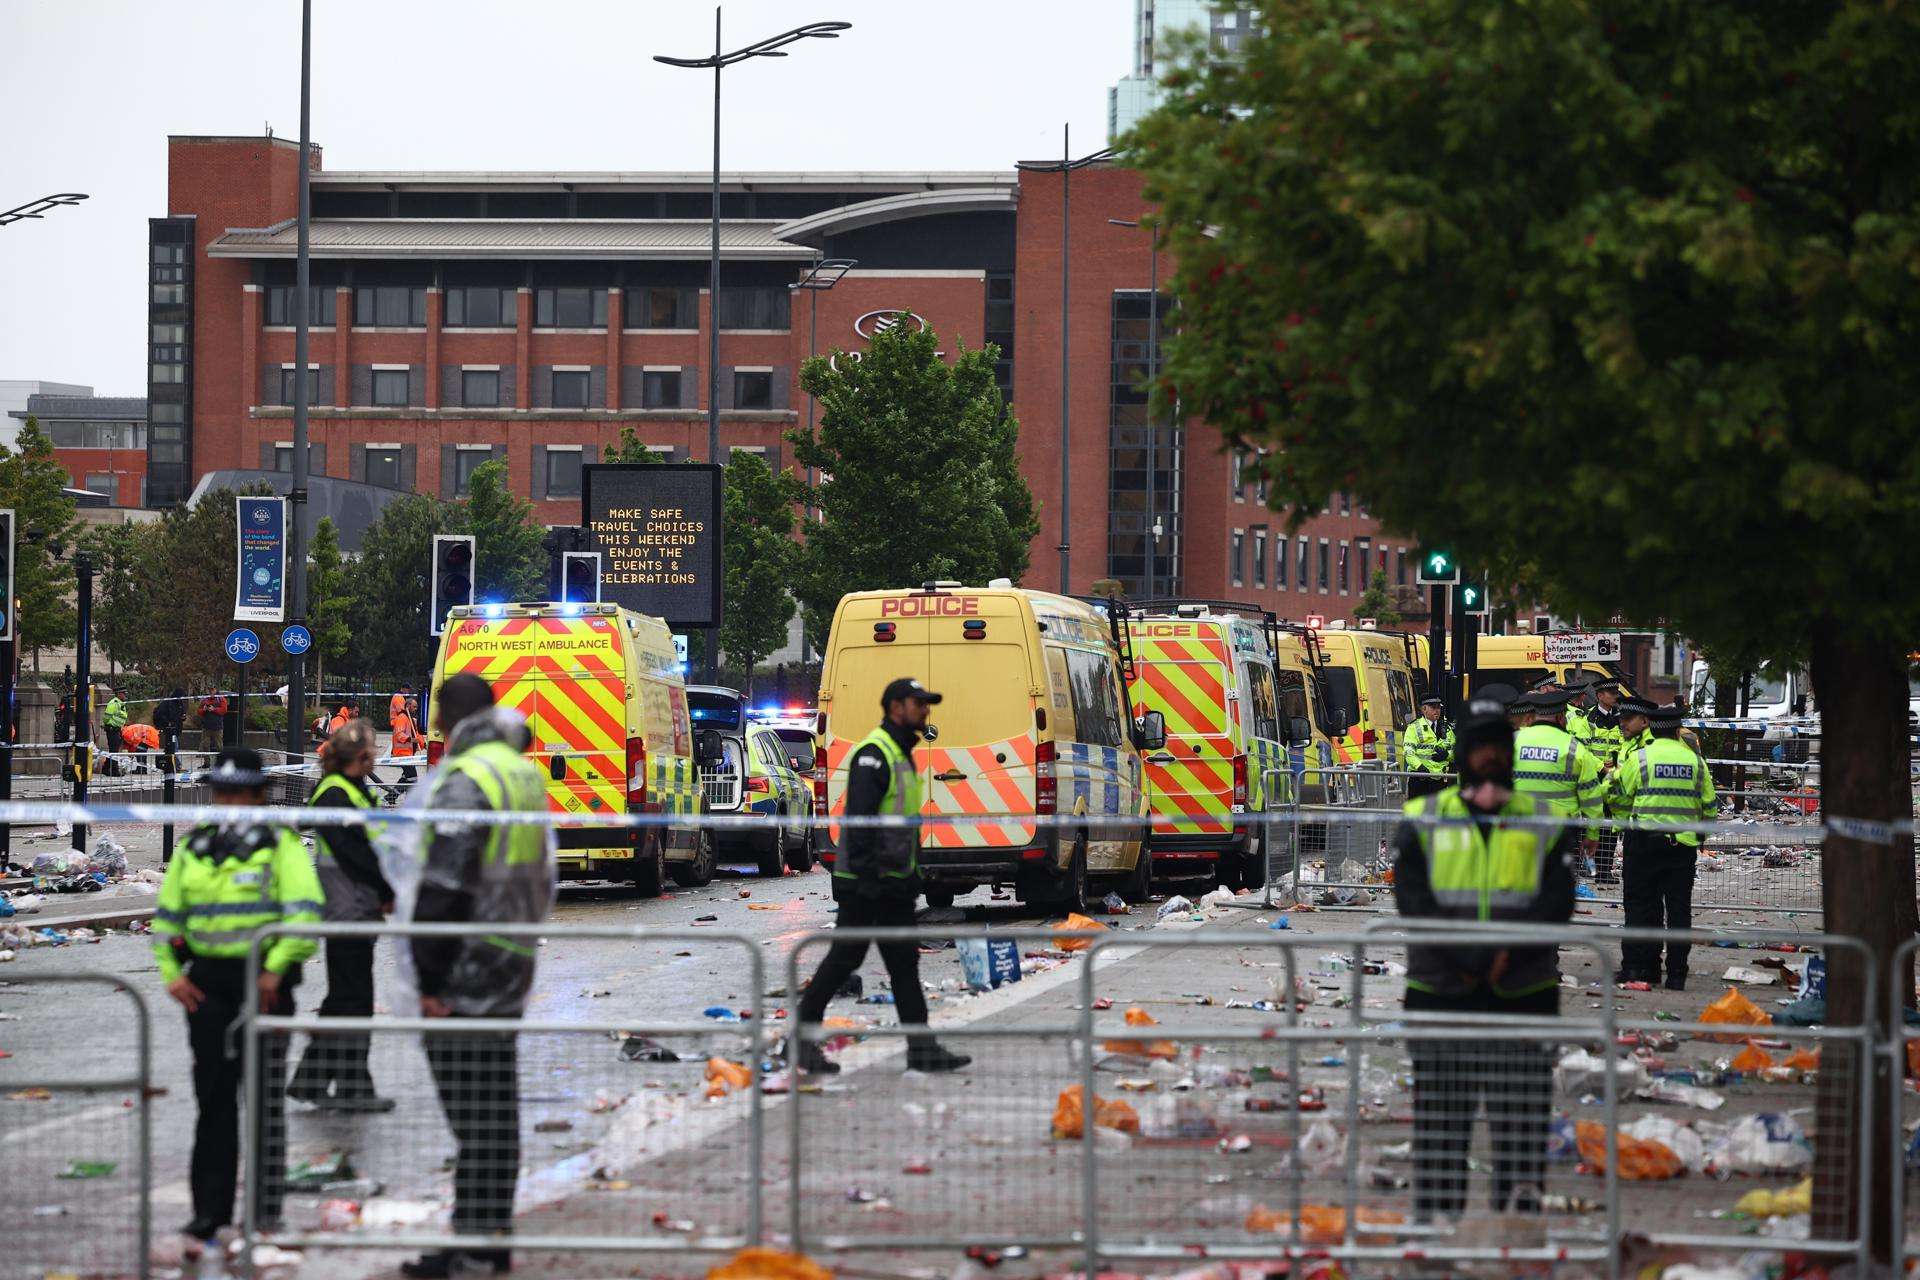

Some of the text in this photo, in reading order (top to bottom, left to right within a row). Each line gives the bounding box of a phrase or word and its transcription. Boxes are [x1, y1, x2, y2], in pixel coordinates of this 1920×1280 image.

[609, 508, 683, 519] MAKE SAFE
[590, 521, 704, 532] TRAVEL CHOICES
[598, 534, 696, 545] THIS WEEKEND
[609, 547, 683, 558] ENJOY THE
[614, 560, 679, 571] EVENTS &
[600, 573, 696, 584] CELEBRATIONS
[881, 596, 979, 618] POLICE
[459, 624, 490, 634] A670
[592, 620, 608, 628] NHS
[458, 639, 609, 651] NORTH WEST AMBULANCE
[1520, 747, 1558, 761] POLICE
[1655, 766, 1692, 778] POLICE
